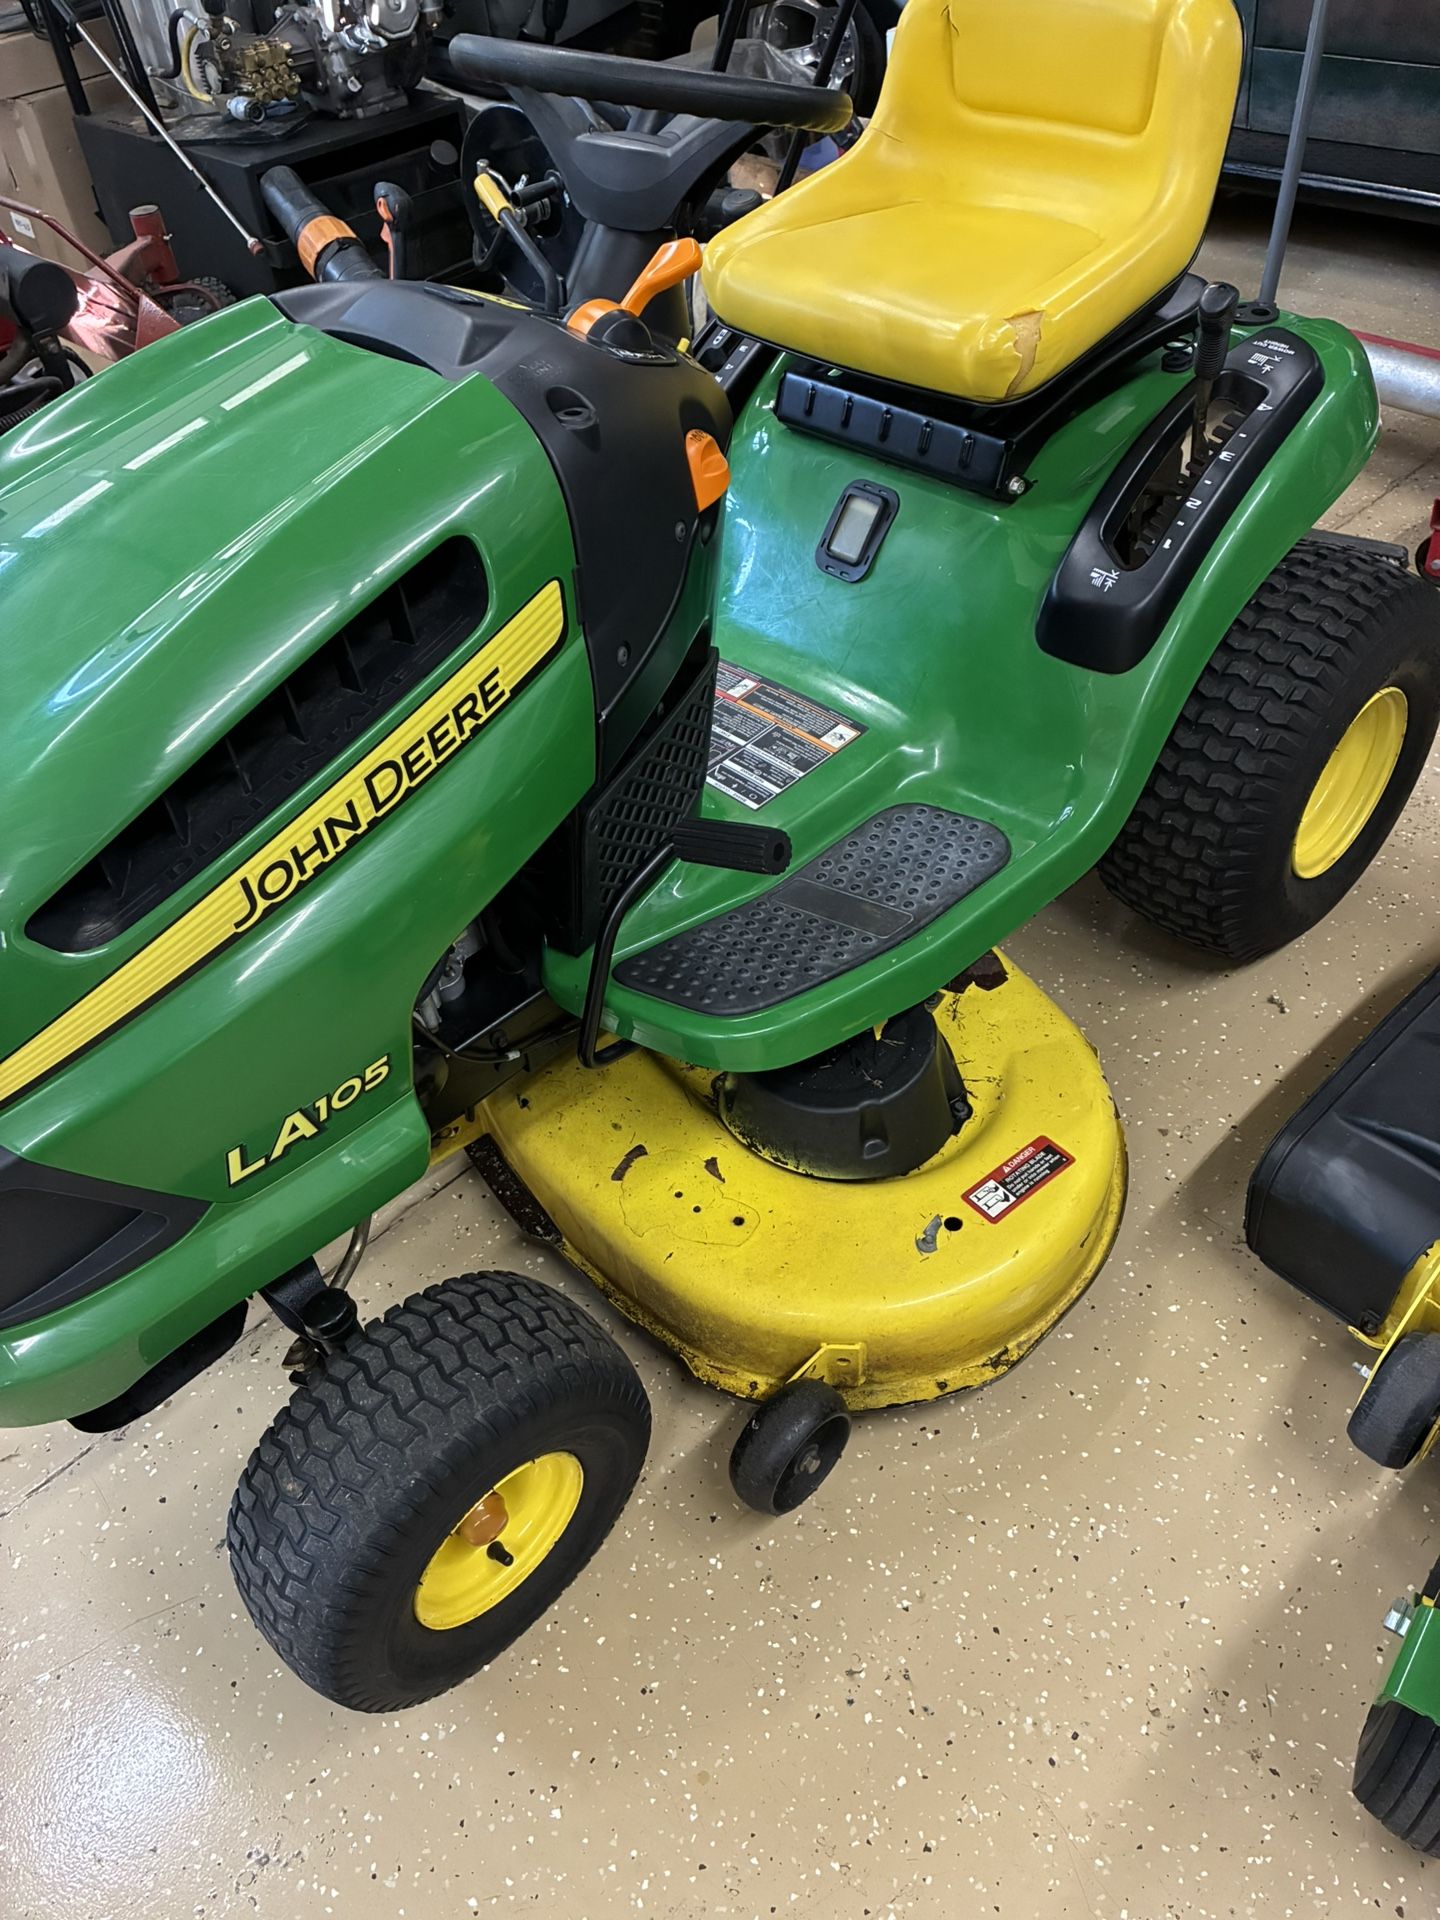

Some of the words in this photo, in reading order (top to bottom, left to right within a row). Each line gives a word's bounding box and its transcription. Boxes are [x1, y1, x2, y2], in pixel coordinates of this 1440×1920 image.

[1267, 344, 1295, 354] MOWER
[1257, 404, 1273, 412] 4
[1218, 451, 1235, 462] 3
[1185, 498, 1202, 510] 2
[1163, 538, 1171, 549] 1
[234, 800, 362, 929] JOHN
[364, 666, 508, 815] DEERE
[227, 1055, 390, 1186] LA105
[1009, 1147, 1035, 1168] DANGER
[1004, 1162, 1030, 1183] ROTATING
[1028, 1150, 1046, 1165] BLADE
[1012, 1176, 1022, 1184] not
[1026, 1162, 1040, 1174] hands
